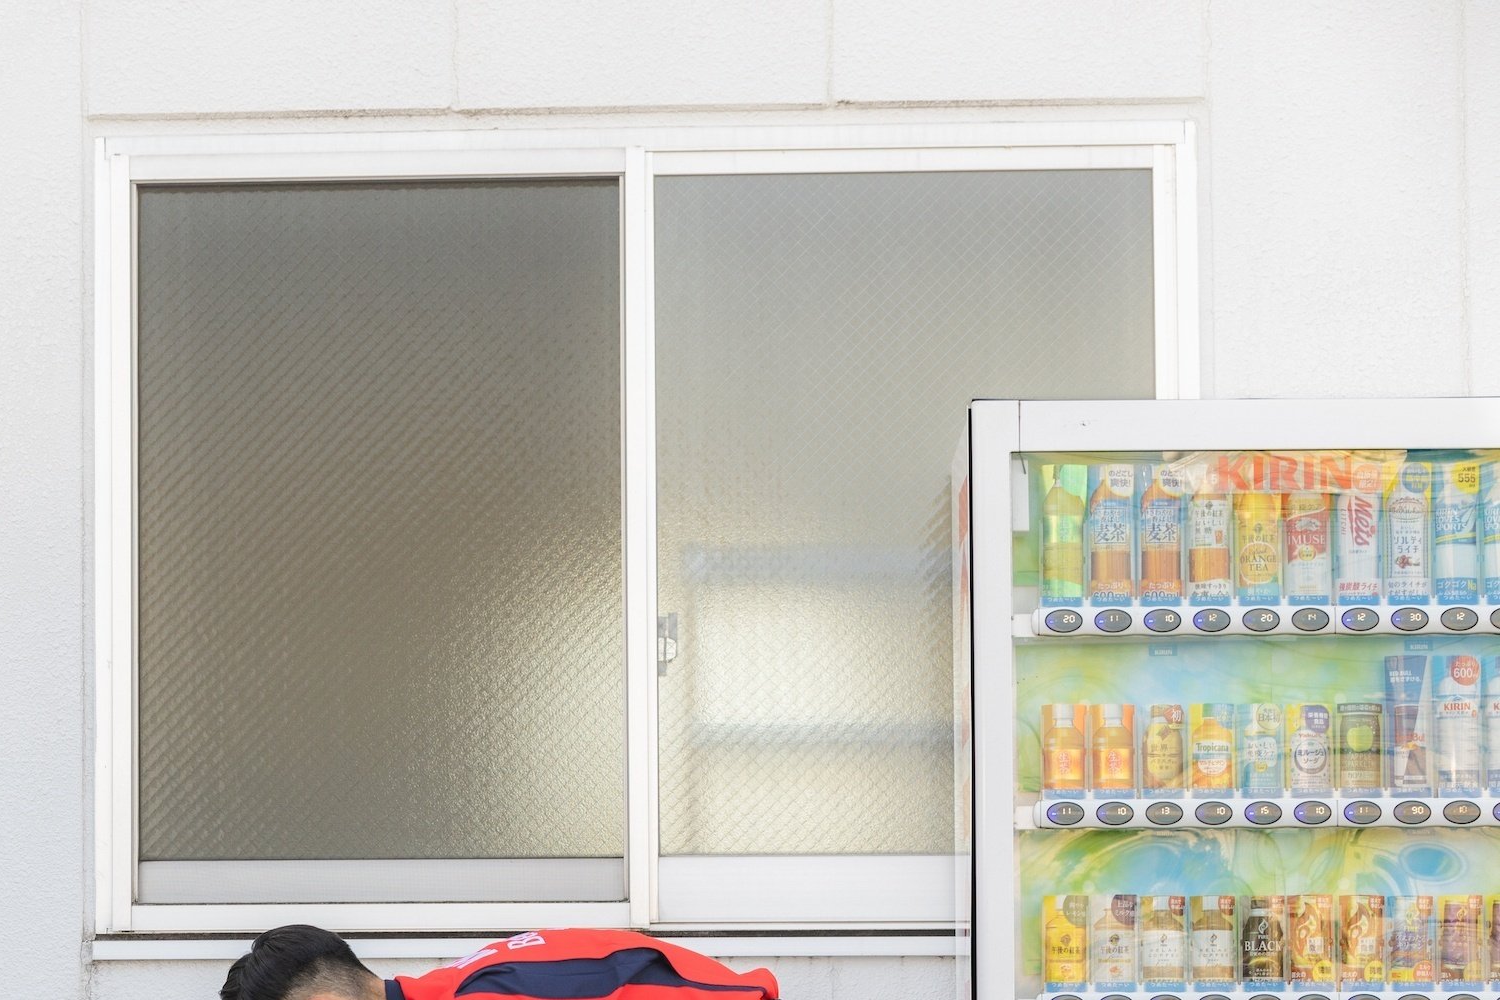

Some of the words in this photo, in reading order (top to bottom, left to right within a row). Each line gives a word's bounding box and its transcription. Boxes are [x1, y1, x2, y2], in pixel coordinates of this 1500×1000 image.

[1218, 455, 1352, 490] KIRIN
[1097, 523, 1126, 542] 麦茶
[1148, 523, 1176, 542] 麦茶
[1444, 702, 1471, 711] KIRIN
[1195, 742, 1229, 752] Tropicana
[1244, 940, 1283, 952] BLACK
